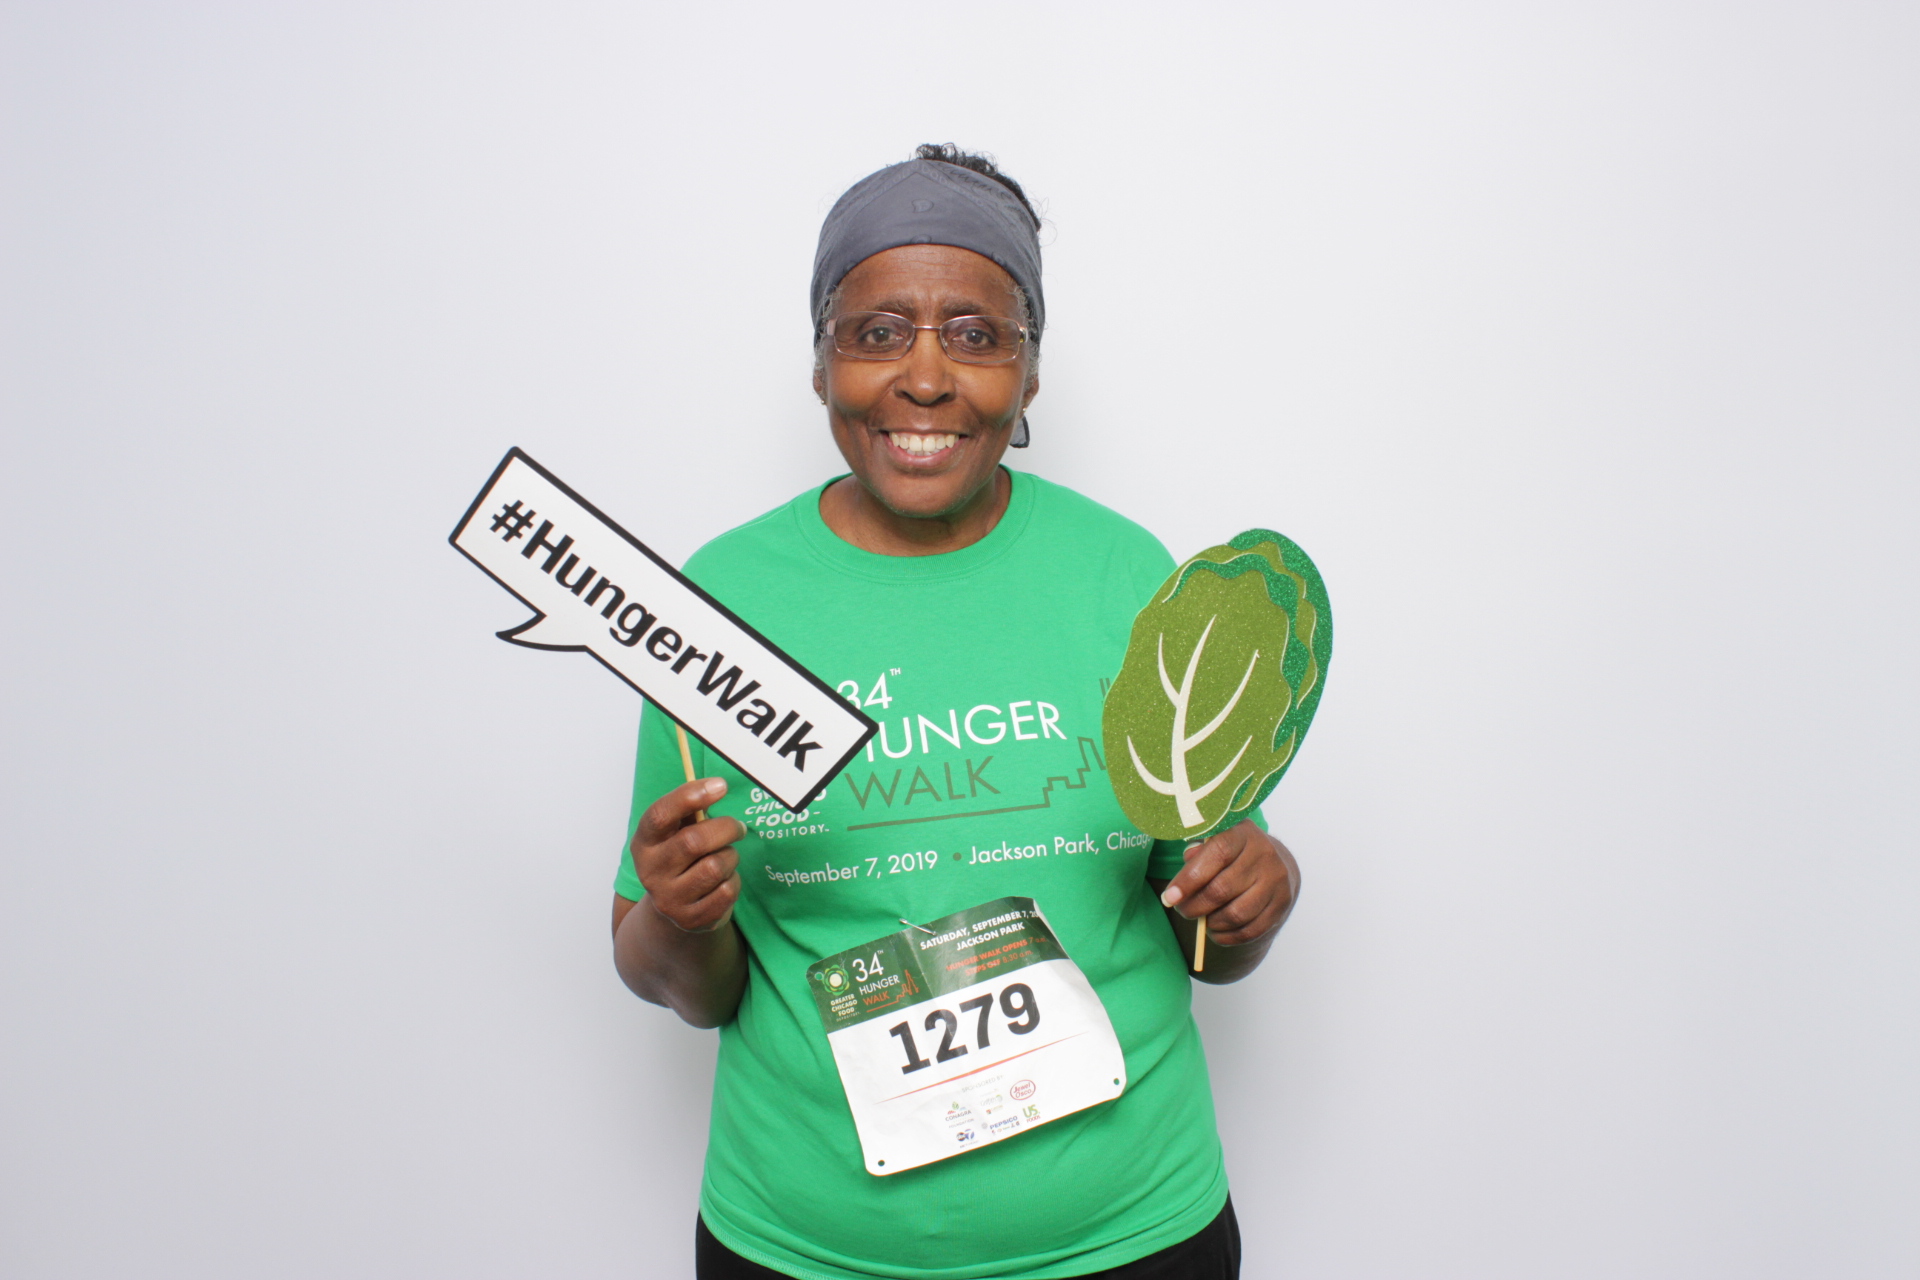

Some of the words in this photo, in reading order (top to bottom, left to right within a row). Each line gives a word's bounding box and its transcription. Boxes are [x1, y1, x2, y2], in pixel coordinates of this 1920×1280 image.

[490, 500, 823, 772] #HungerWalk
[866, 701, 1067, 762] UNGER
[844, 756, 1001, 811] WALK
[755, 808, 809, 827] FOOD
[765, 862, 859, 887] September
[865, 857, 882, 879] 7,
[888, 850, 938, 875] 2019
[969, 841, 1048, 865] Jackson
[1054, 833, 1099, 855] Park,
[920, 927, 970, 951] SATURDAY,
[972, 911, 1021, 933] SEPTEMBER
[956, 930, 999, 951] JACKSON
[1000, 922, 1025, 937] PARK
[946, 956, 979, 972] HUNGER
[980, 948, 1001, 960] WALK
[1002, 939, 1028, 953] OPENS
[830, 993, 855, 1006] GREATER
[859, 974, 900, 996] HUNGER
[862, 991, 890, 1006] WALK
[831, 999, 858, 1012] CHICAGO
[838, 1007, 855, 1017] FOOD
[889, 983, 1041, 1075] 1279
